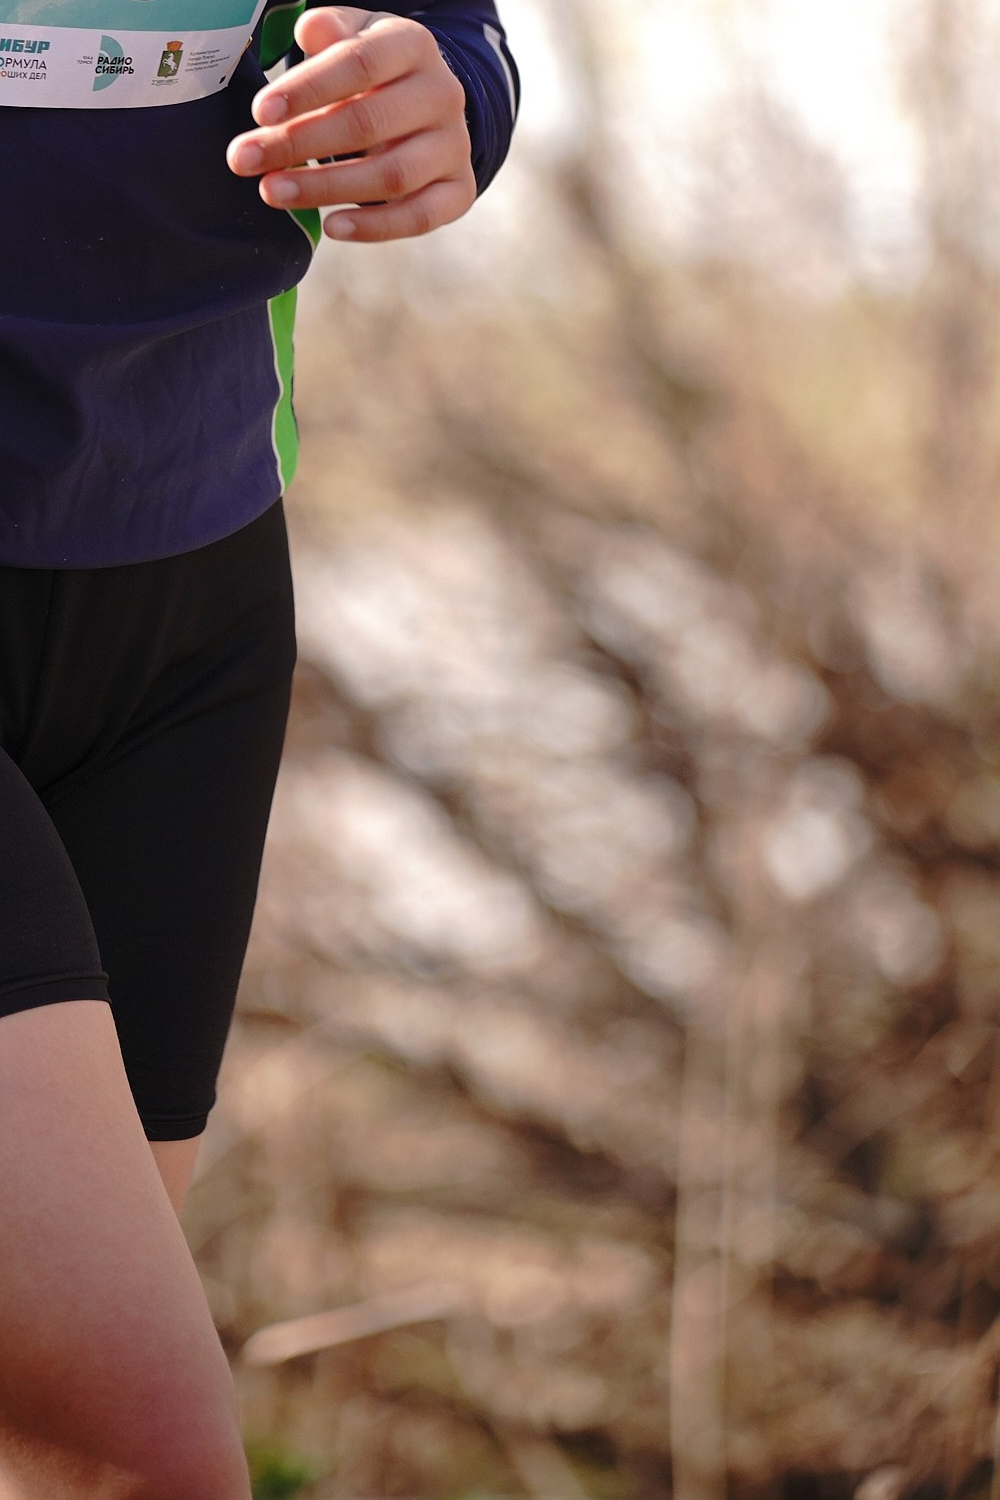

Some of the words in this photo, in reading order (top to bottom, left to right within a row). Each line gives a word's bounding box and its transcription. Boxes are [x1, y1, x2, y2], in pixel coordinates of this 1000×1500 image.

[97, 56, 133, 66] РАДИО
[94, 65, 135, 75] СИБИРЬ
[28, 71, 47, 81] ДЕЛ
